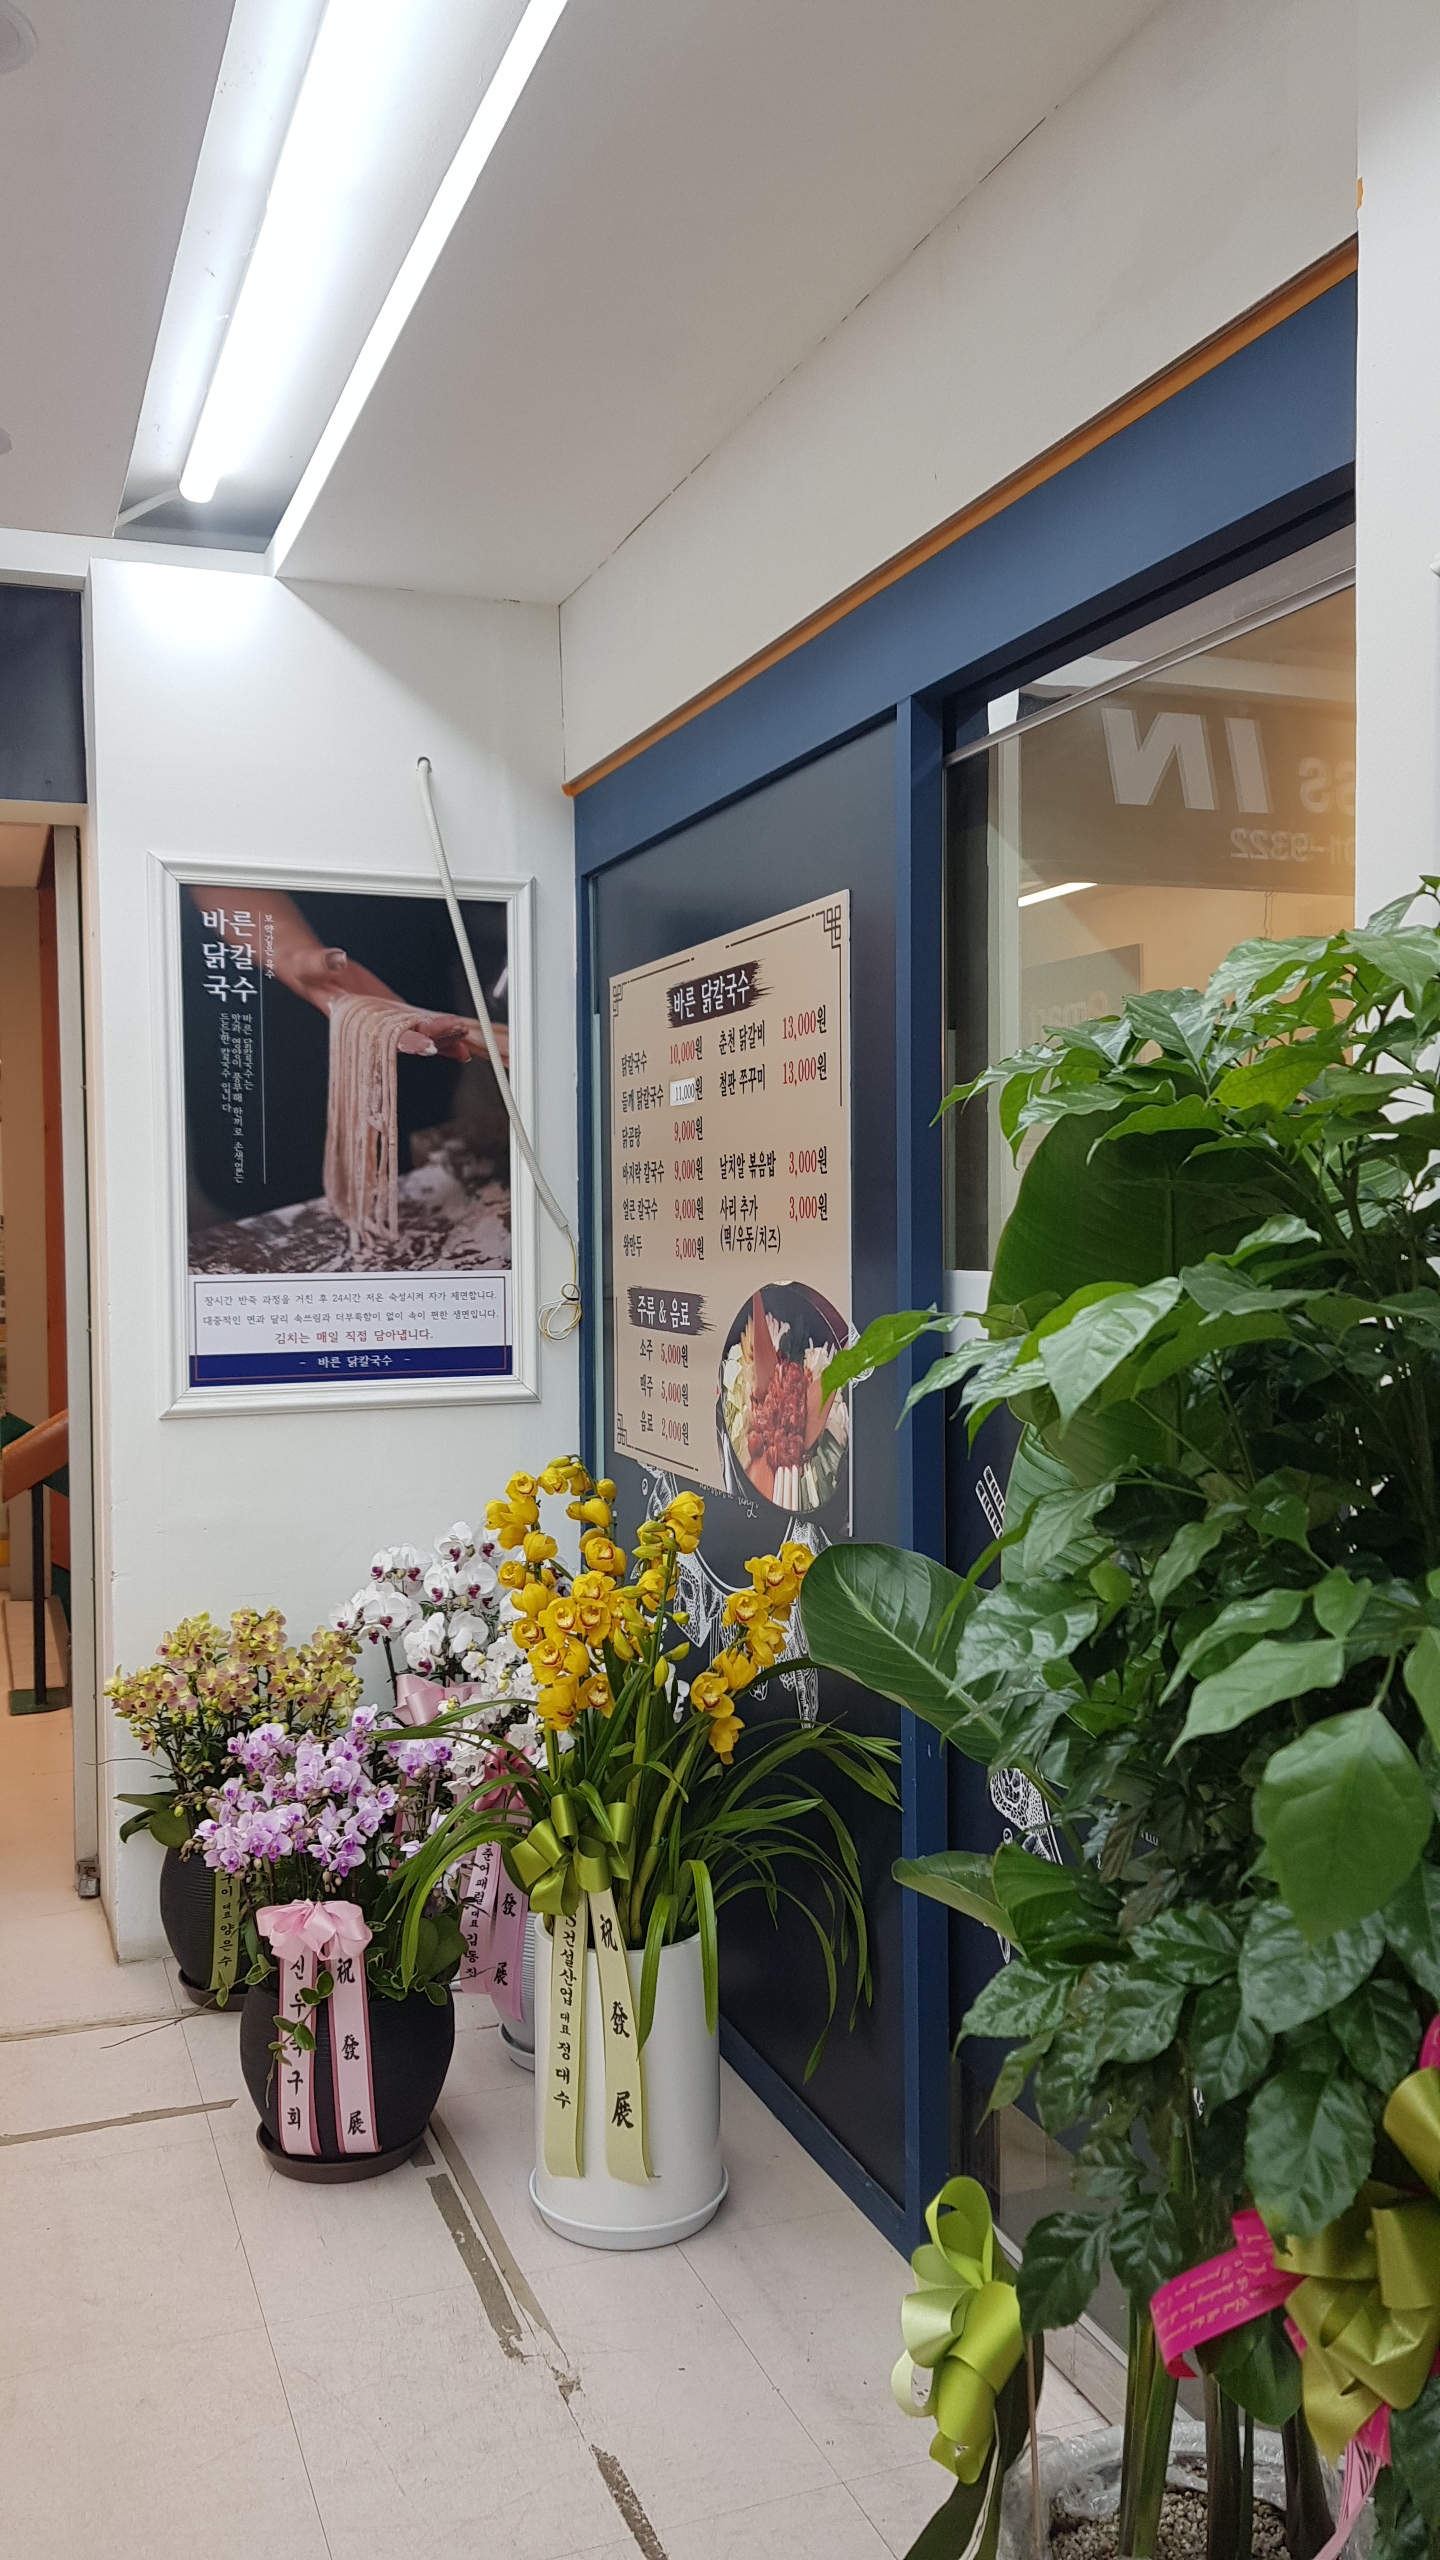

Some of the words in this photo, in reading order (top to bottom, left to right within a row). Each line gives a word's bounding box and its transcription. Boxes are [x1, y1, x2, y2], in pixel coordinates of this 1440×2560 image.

[201, 908, 256, 936] 바른
[201, 941, 256, 970] 닭칼
[202, 975, 258, 1003] 국수
[674, 986, 696, 1021] 바른
[701, 969, 750, 1014] 닭칼국수
[219, 1013, 231, 1045] 든든한
[231, 1013, 241, 1033] 맛과
[242, 1013, 253, 1035] 바른
[718, 1027, 735, 1055] 춘천
[739, 1020, 765, 1052] 닭갈비
[782, 1004, 827, 1041] 13,000원
[220, 1047, 231, 1078] 칼국수
[231, 1038, 242, 1068] 영양이
[621, 1050, 647, 1077] 닭칼국수
[670, 1035, 703, 1065] 10,000원
[232, 1072, 243, 1103] 풍부해
[719, 1070, 736, 1097] 철판
[739, 1064, 766, 1095] 쭈꾸미
[783, 1052, 827, 1087] 13,000원
[221, 1082, 232, 1113] 입니다
[622, 1089, 634, 1113] 들깨
[636, 1084, 664, 1111] 닭칼국수
[233, 1107, 244, 1136] 한끼로
[622, 1124, 641, 1149] 닭곰탕
[674, 1115, 703, 1144] 9,000원
[622, 1161, 642, 1185] 바지락
[644, 1159, 665, 1184] 칼국수
[674, 1156, 704, 1182] 9,000원
[719, 1152, 746, 1180] 날치알
[748, 1150, 776, 1179] 볶음밥
[789, 1146, 828, 1178] 3,000원
[623, 1198, 636, 1221] 얼큰
[638, 1198, 658, 1221] 칼국수
[674, 1196, 704, 1222] 9,000원
[719, 1195, 736, 1222] 사리
[740, 1194, 758, 1222] 추가
[789, 1192, 828, 1223] 3,000원
[623, 1234, 643, 1258] 왕만두
[675, 1236, 704, 1260] 5,000원
[204, 1295, 233, 1306] 장시간
[238, 1295, 257, 1305] 반죽
[263, 1294, 290, 1305] 과정을
[295, 1294, 314, 1304] 거친
[318, 1293, 328, 1303] 후
[332, 1293, 361, 1303] 24시간
[366, 1293, 384, 1302] 저온
[388, 1292, 424, 1302] 숙성시켜
[428, 1291, 446, 1300] 자가
[451, 1290, 498, 1301] 제면합니다.
[637, 1295, 656, 1326] 주류
[658, 1299, 667, 1324] &
[669, 1298, 691, 1328] 음료
[203, 1315, 241, 1326] 대중적인
[246, 1314, 265, 1325] 면과
[270, 1314, 289, 1324] 달리
[294, 1313, 331, 1324] 속쓰림과
[335, 1312, 381, 1323] 더부룩함이
[386, 1311, 403, 1321] 없이
[408, 1310, 426, 1321] 속이
[430, 1310, 448, 1320] 편한
[275, 1332, 310, 1344] 김치는
[316, 1331, 339, 1343] 매일
[345, 1330, 367, 1342] 직접
[374, 1328, 433, 1342] 담아냅니다.
[318, 1356, 342, 1369] 바른
[347, 1355, 393, 1368] 닭칼국수
[639, 1338, 653, 1361] 소주
[660, 1343, 688, 1368] 5,000원
[640, 1374, 654, 1398] 맥주
[661, 1381, 689, 1407] 5,000원
[640, 1410, 654, 1432] 음료
[661, 1418, 689, 1446] 2,000원
[474, 1840, 494, 1905] 준어패럴
[560, 2011, 571, 2035] 대표
[553, 2041, 571, 2110] 정대수
